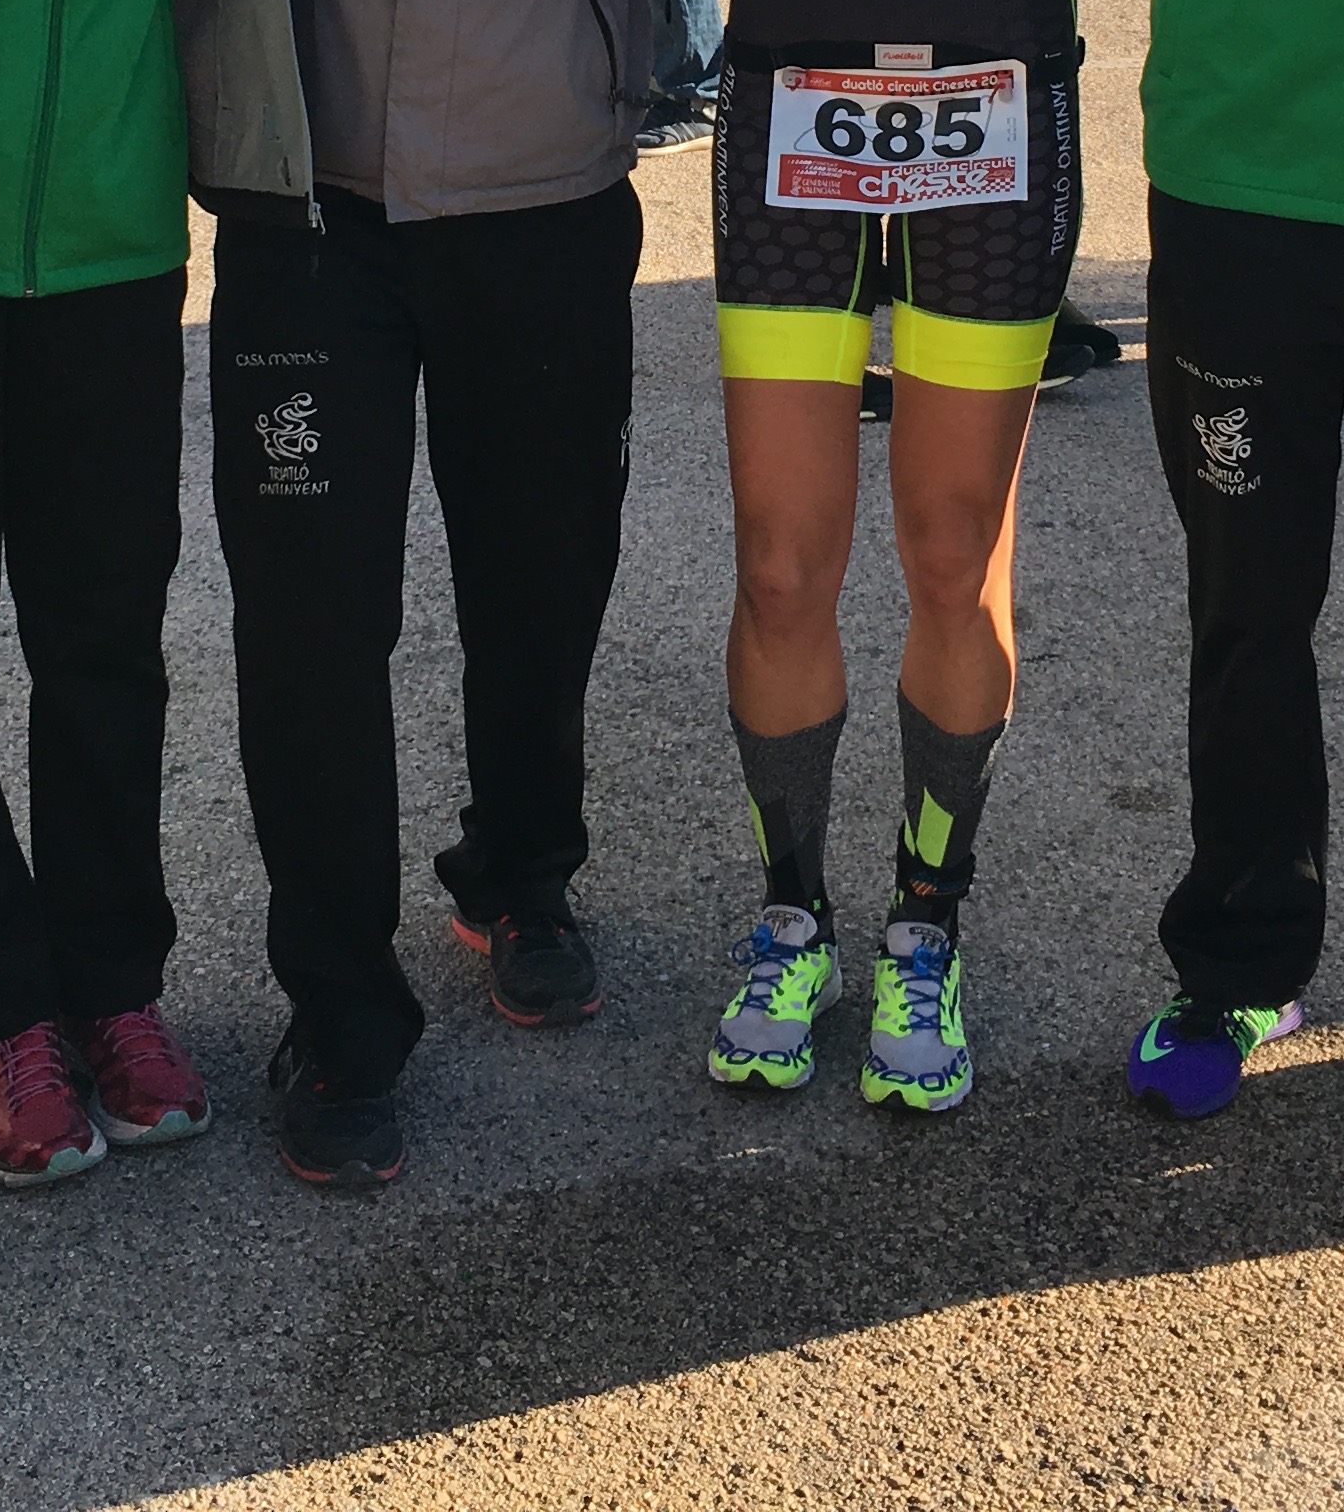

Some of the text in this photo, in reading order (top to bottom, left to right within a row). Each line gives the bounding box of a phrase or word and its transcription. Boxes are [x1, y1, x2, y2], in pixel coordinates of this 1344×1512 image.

[719, 63, 736, 113] ATLÓ
[841, 78, 883, 92] duatló
[887, 79, 930, 93] circuit
[933, 77, 978, 92] Cheste
[981, 75, 998, 86] 20
[814, 97, 986, 162] 685
[891, 156, 1016, 177] duatló circuit
[858, 164, 989, 198] cheste
[1051, 175, 1071, 256] TRIATLÓ
[235, 349, 330, 367] CASA MODA'S
[1203, 371, 1264, 389] MODA'S
[268, 462, 310, 481] TRIATLÓ
[259, 480, 330, 495] ONTINYENT
